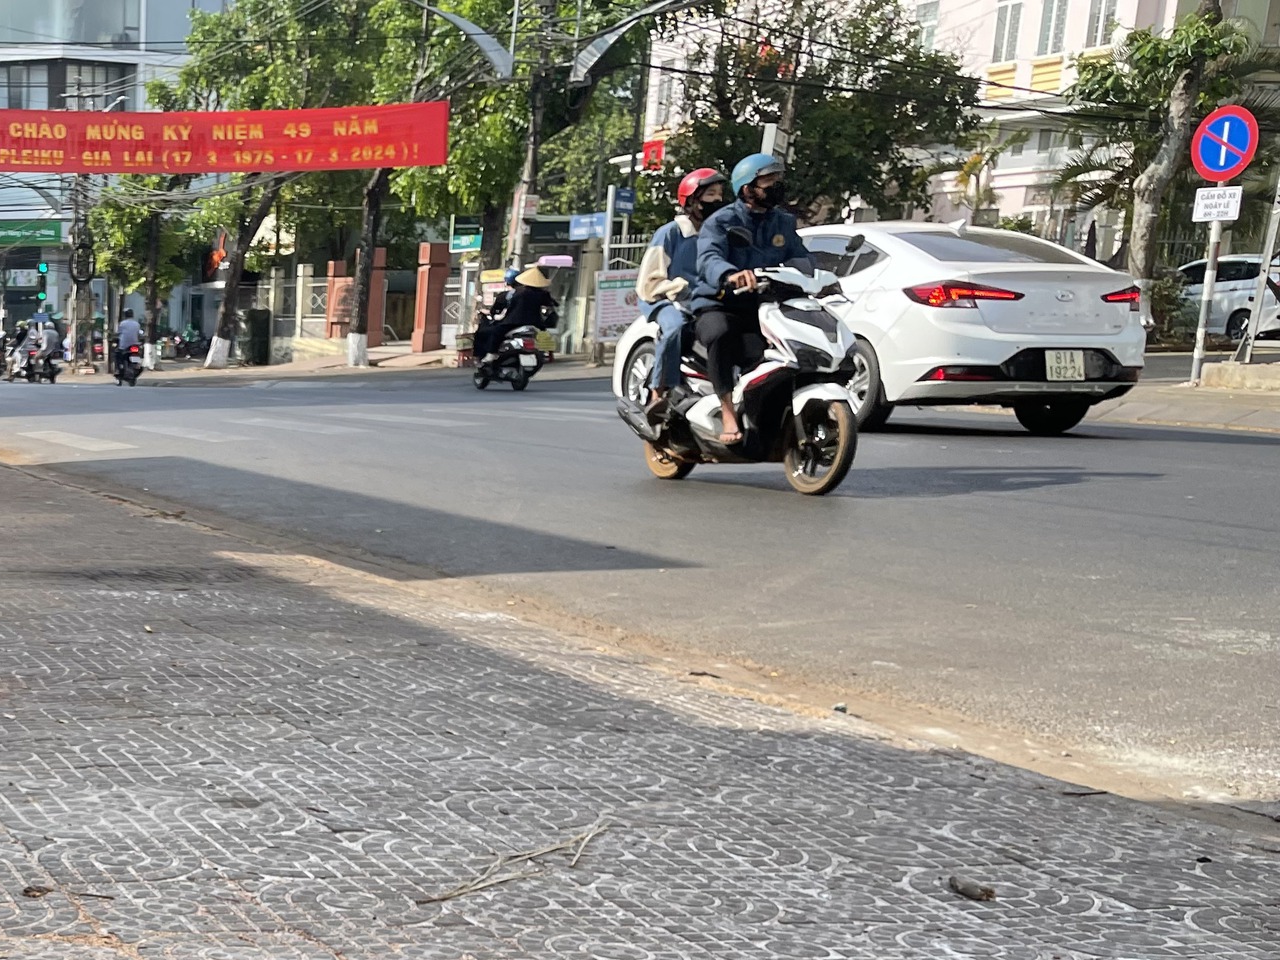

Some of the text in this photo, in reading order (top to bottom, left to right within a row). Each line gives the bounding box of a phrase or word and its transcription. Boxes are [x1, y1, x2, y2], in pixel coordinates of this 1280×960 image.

[9, 116, 67, 139] CHÀO
[86, 116, 145, 140] MỪNG
[162, 117, 192, 141] KỶ
[212, 117, 264, 146] NIỆM
[283, 122, 312, 138] 49
[332, 114, 379, 136] NĂM
[81, 151, 112, 167] GIA
[123, 151, 153, 167] LAI
[1055, 351, 1075, 364] 81A
